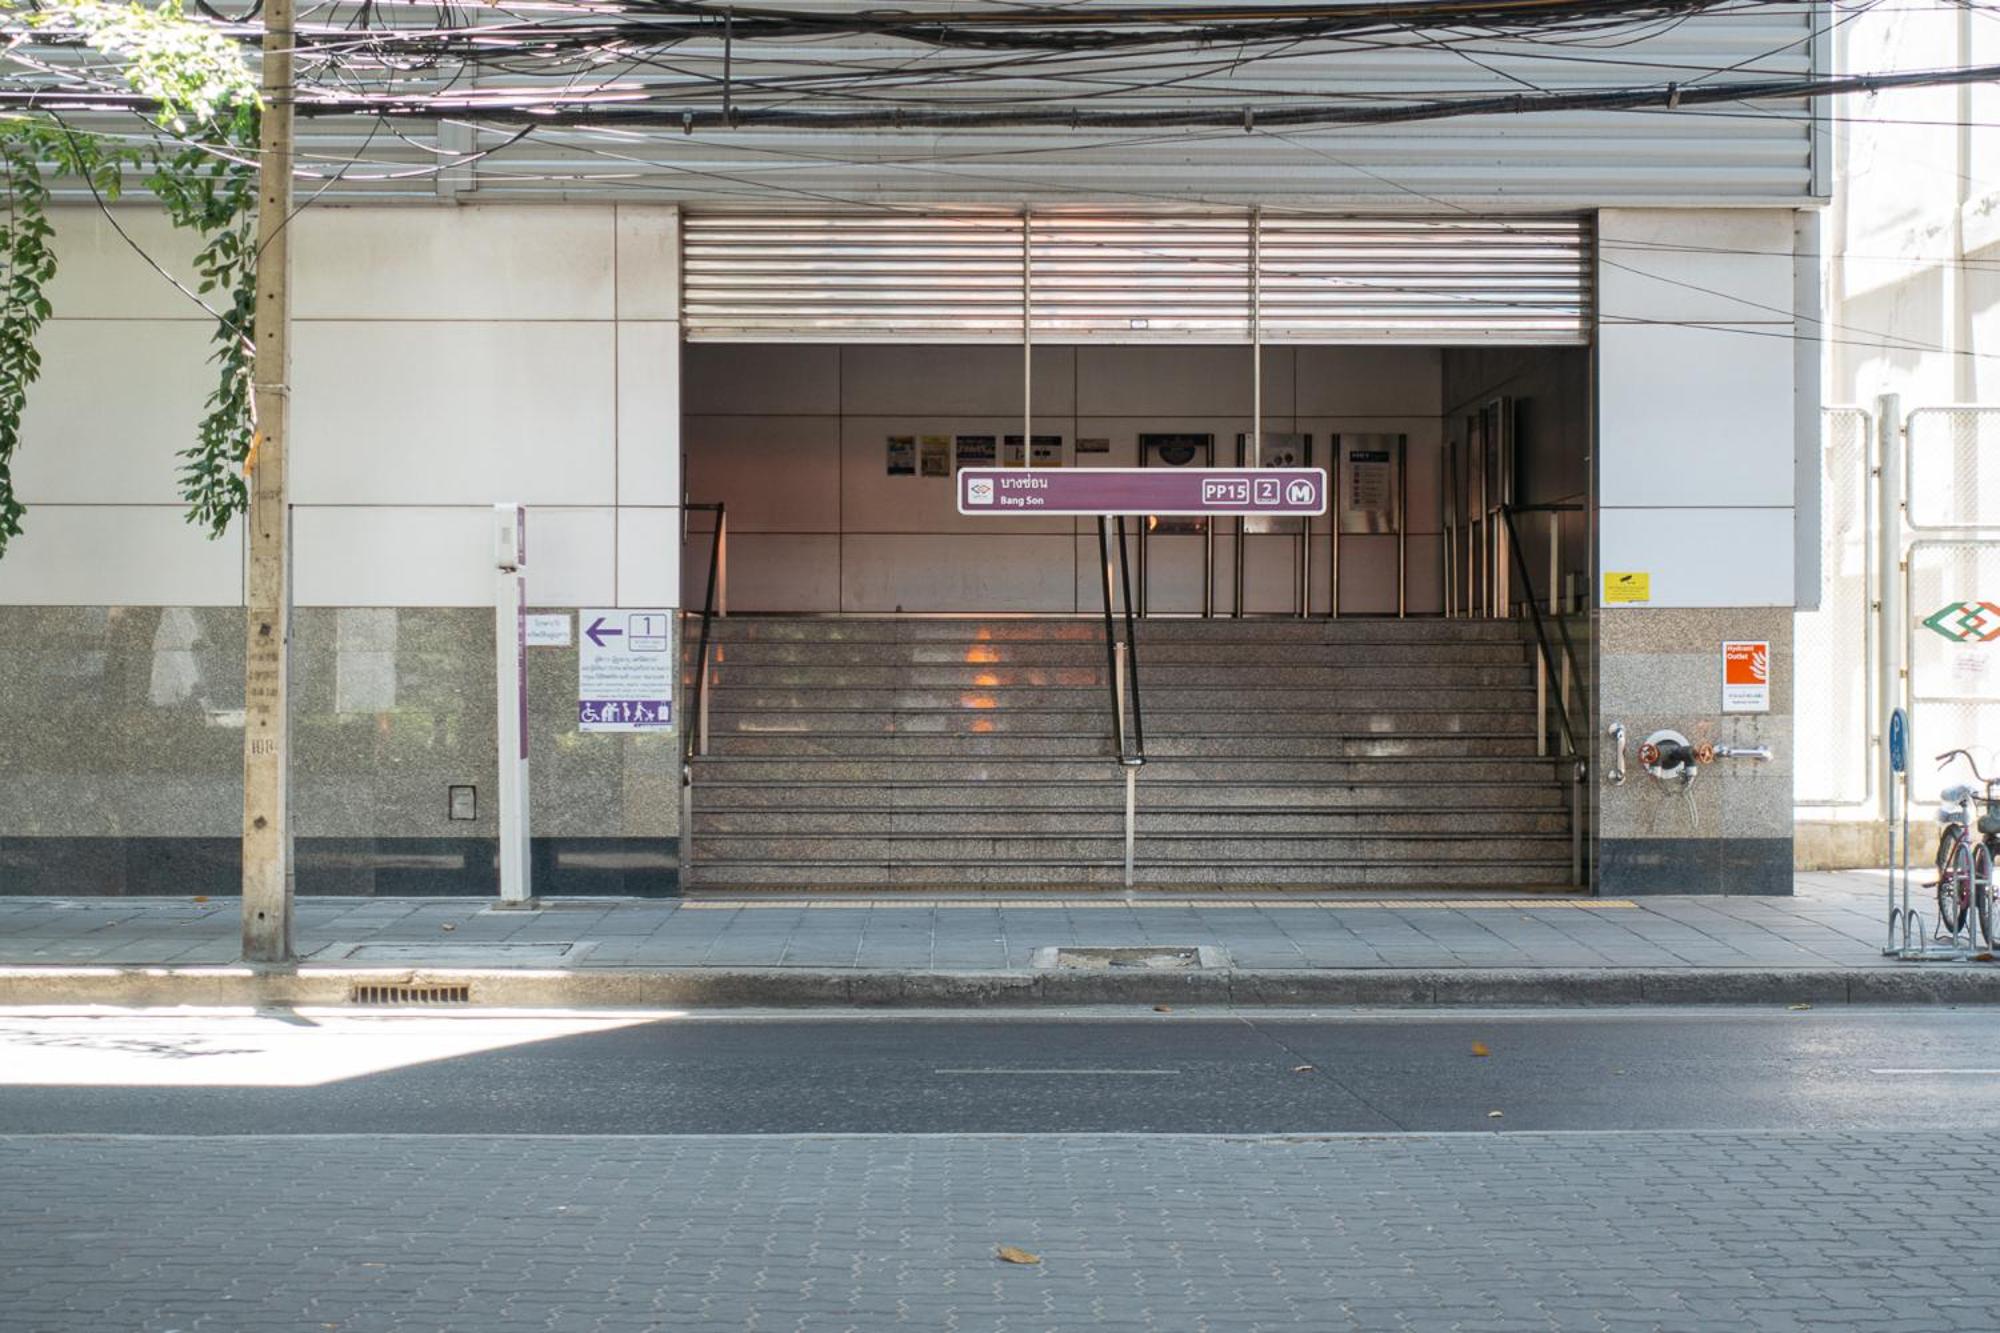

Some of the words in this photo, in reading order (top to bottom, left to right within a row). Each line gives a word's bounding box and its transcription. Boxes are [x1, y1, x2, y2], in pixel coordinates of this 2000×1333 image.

[1206, 484, 1247, 499] PP15
[1262, 483, 1272, 497] 2
[1290, 485, 1311, 502] M
[1000, 495, 1025, 507] Bang
[1026, 496, 1044, 505] Son
[643, 616, 651, 635] 1
[1727, 653, 1749, 661] Outlet
[1894, 715, 1900, 741] P
